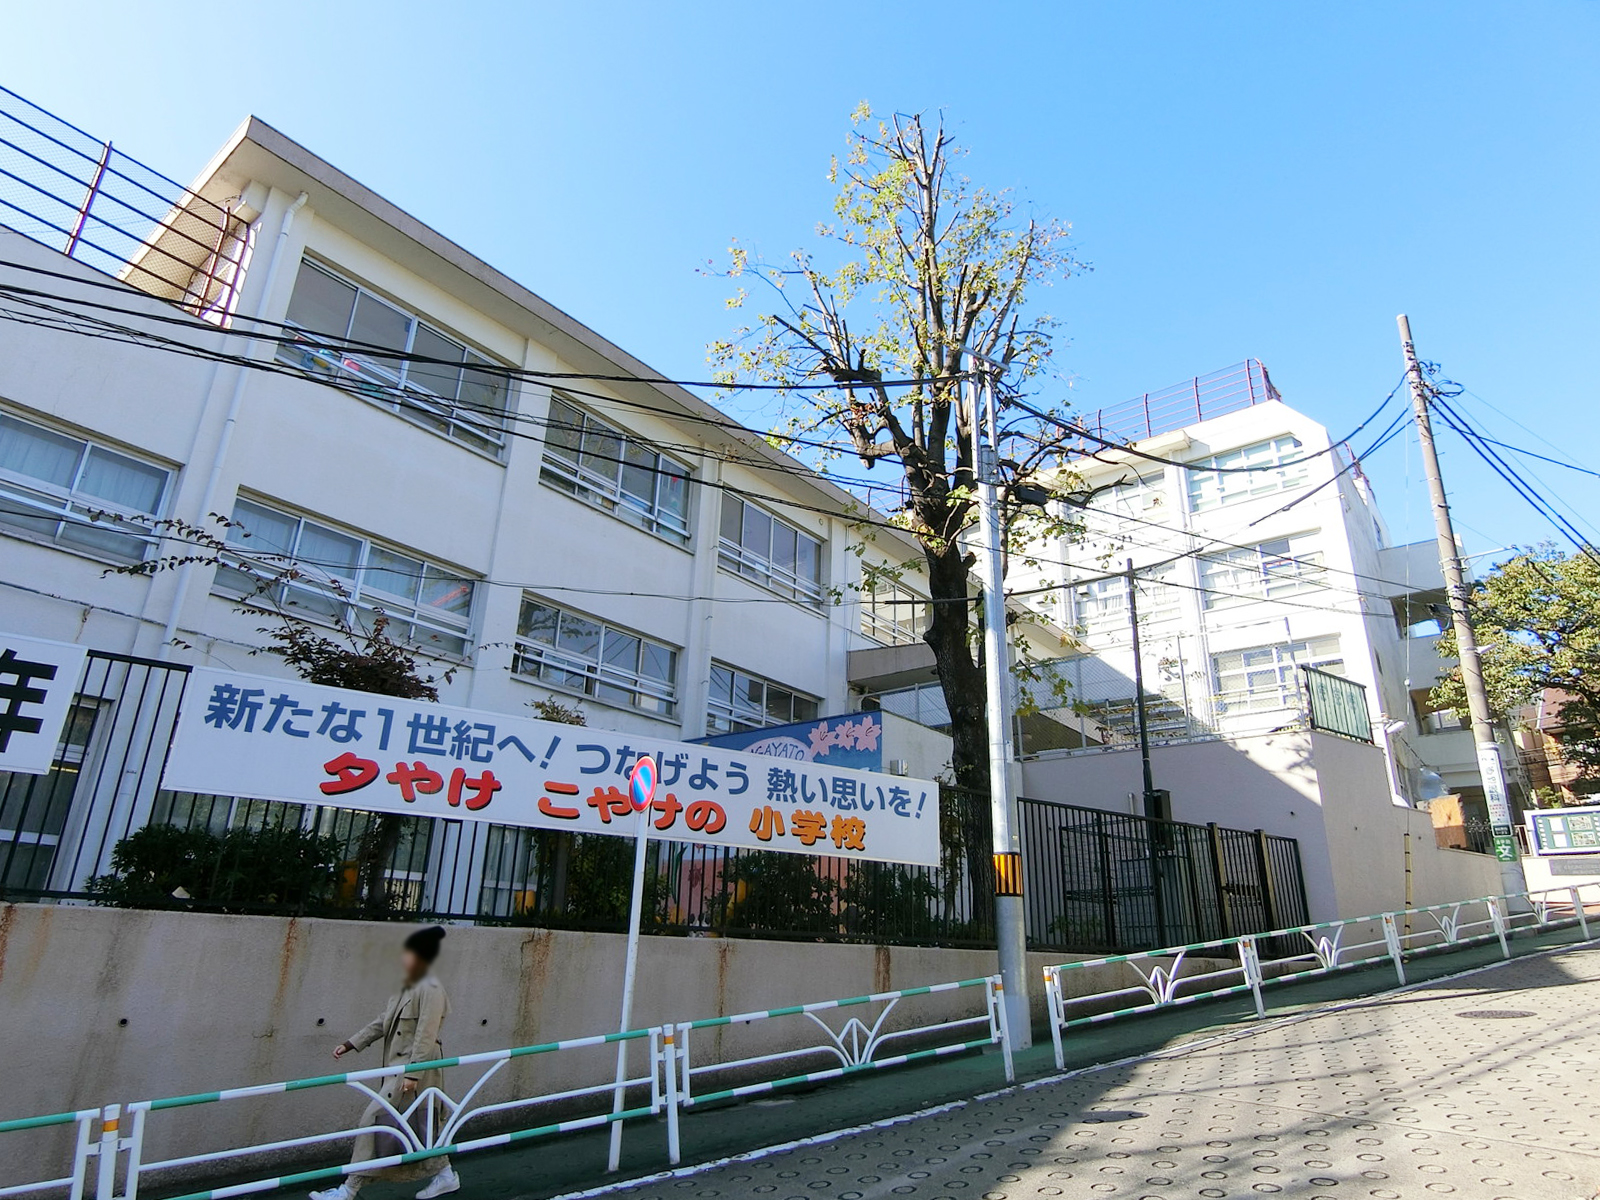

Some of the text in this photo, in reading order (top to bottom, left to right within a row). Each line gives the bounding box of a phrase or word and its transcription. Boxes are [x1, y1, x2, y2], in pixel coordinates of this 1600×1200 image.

[319, 751, 502, 812] 夕やけ
[748, 804, 867, 852] 小学校
[576, 743, 750, 795] つなげよう
[766, 766, 927, 820] 熱い思いを！
